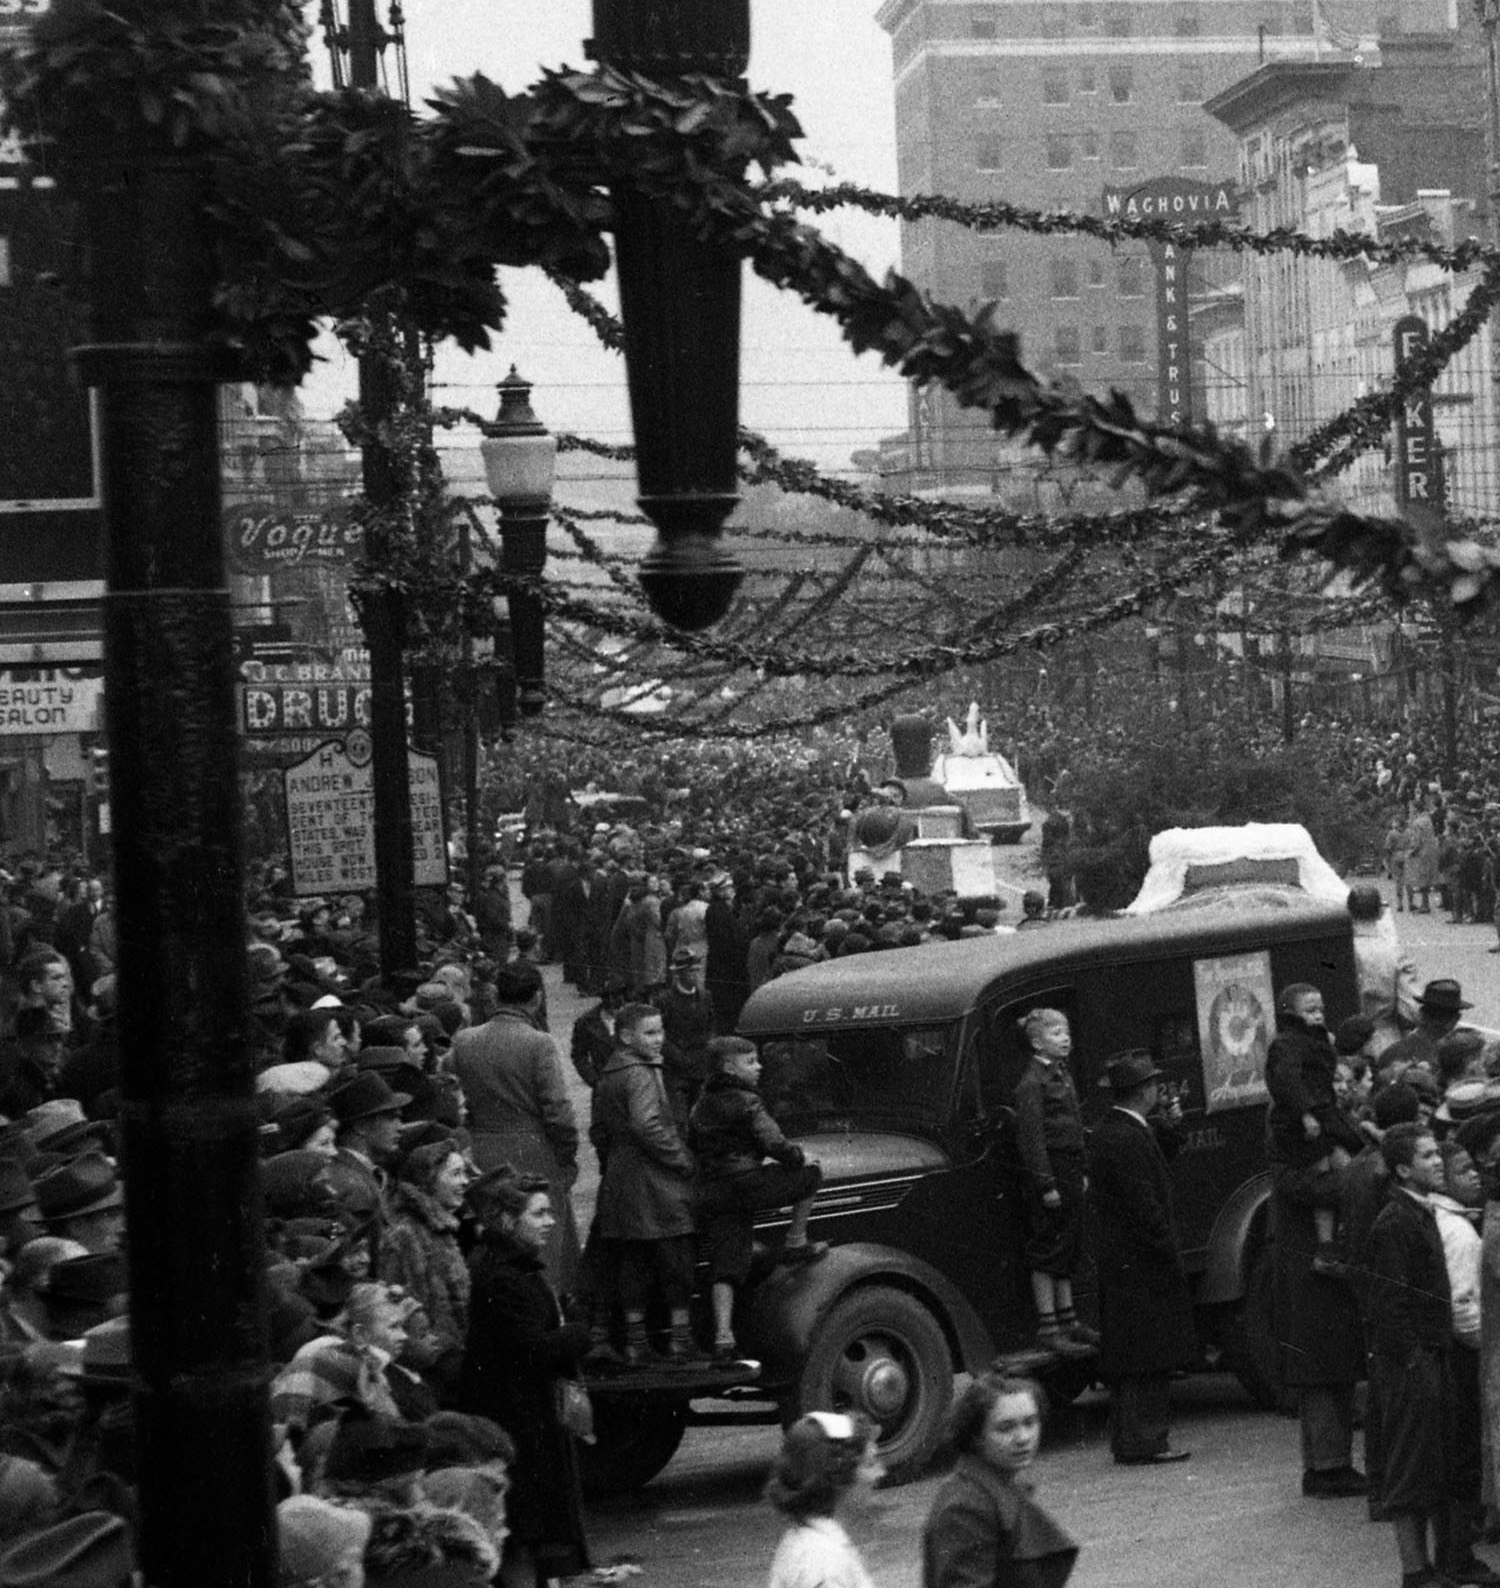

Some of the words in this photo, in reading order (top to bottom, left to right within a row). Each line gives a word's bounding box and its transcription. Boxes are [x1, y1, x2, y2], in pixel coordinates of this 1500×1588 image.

[1106, 190, 1230, 214] WACHOVIA
[1164, 244, 1176, 303] ANK
[240, 513, 365, 567] Vogue
[290, 773, 353, 793] ANDREW
[852, 1004, 901, 1020] MAIL
